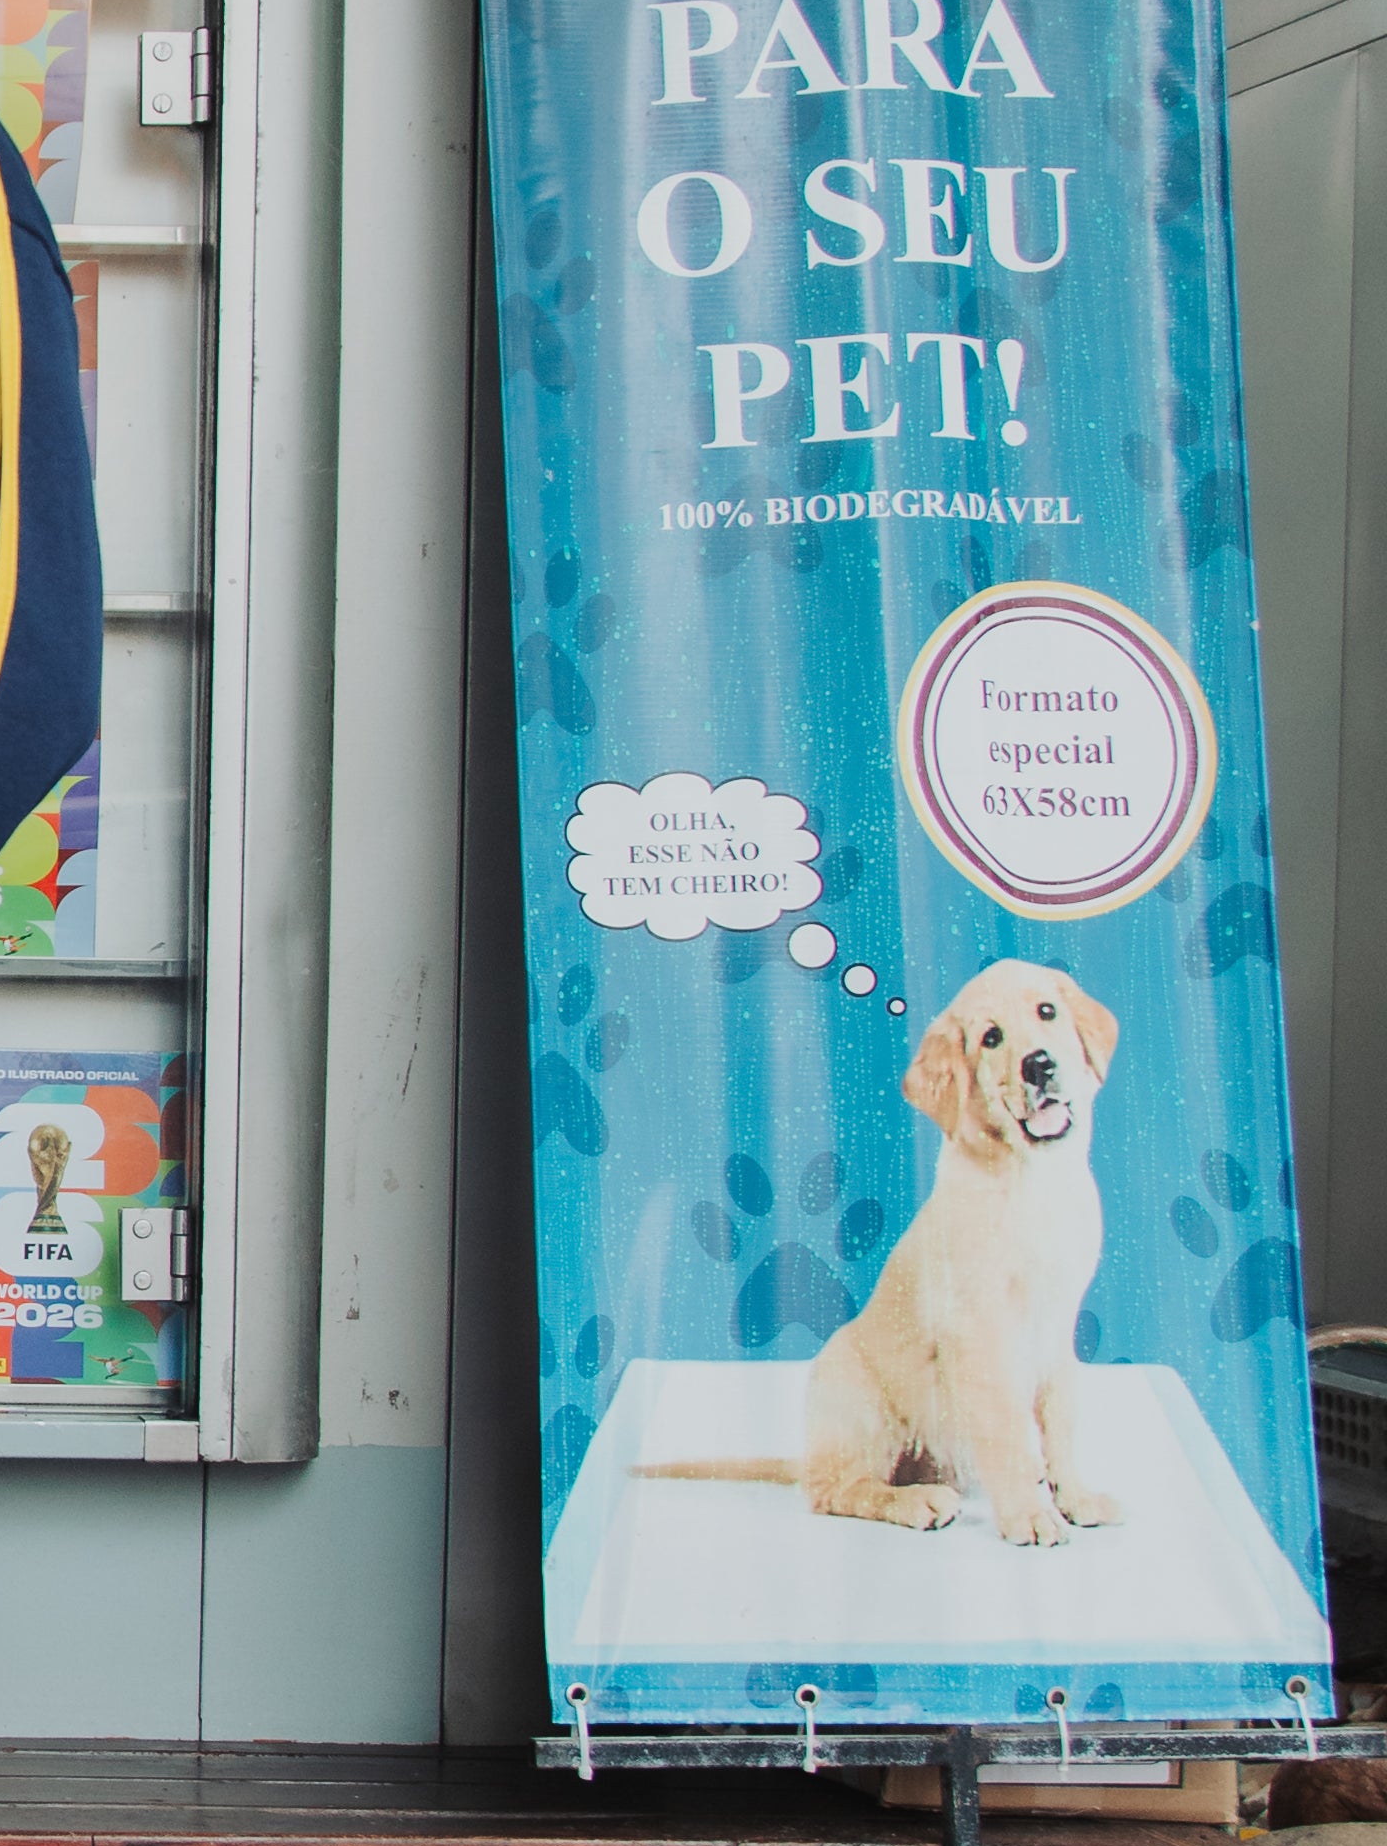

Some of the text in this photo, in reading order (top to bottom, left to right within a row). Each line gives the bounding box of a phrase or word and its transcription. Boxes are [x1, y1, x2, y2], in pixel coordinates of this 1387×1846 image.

[634, 156, 1079, 280] O SEU
[696, 330, 1030, 450] PET!
[658, 487, 1082, 531] 100% BIODEGRADÁVEL
[979, 678, 1120, 713] Formato
[988, 734, 1116, 774] especial
[982, 784, 1131, 818] 63X58cm
[649, 810, 736, 833] OLHA,
[627, 837, 761, 865] ESSE NÃO
[602, 871, 789, 897] TEM CHEIRO!
[7, 1068, 140, 1082] ILUSTRADO OFICIAL
[23, 1242, 74, 1261] FIFA
[63, 1283, 104, 1301] CUP
